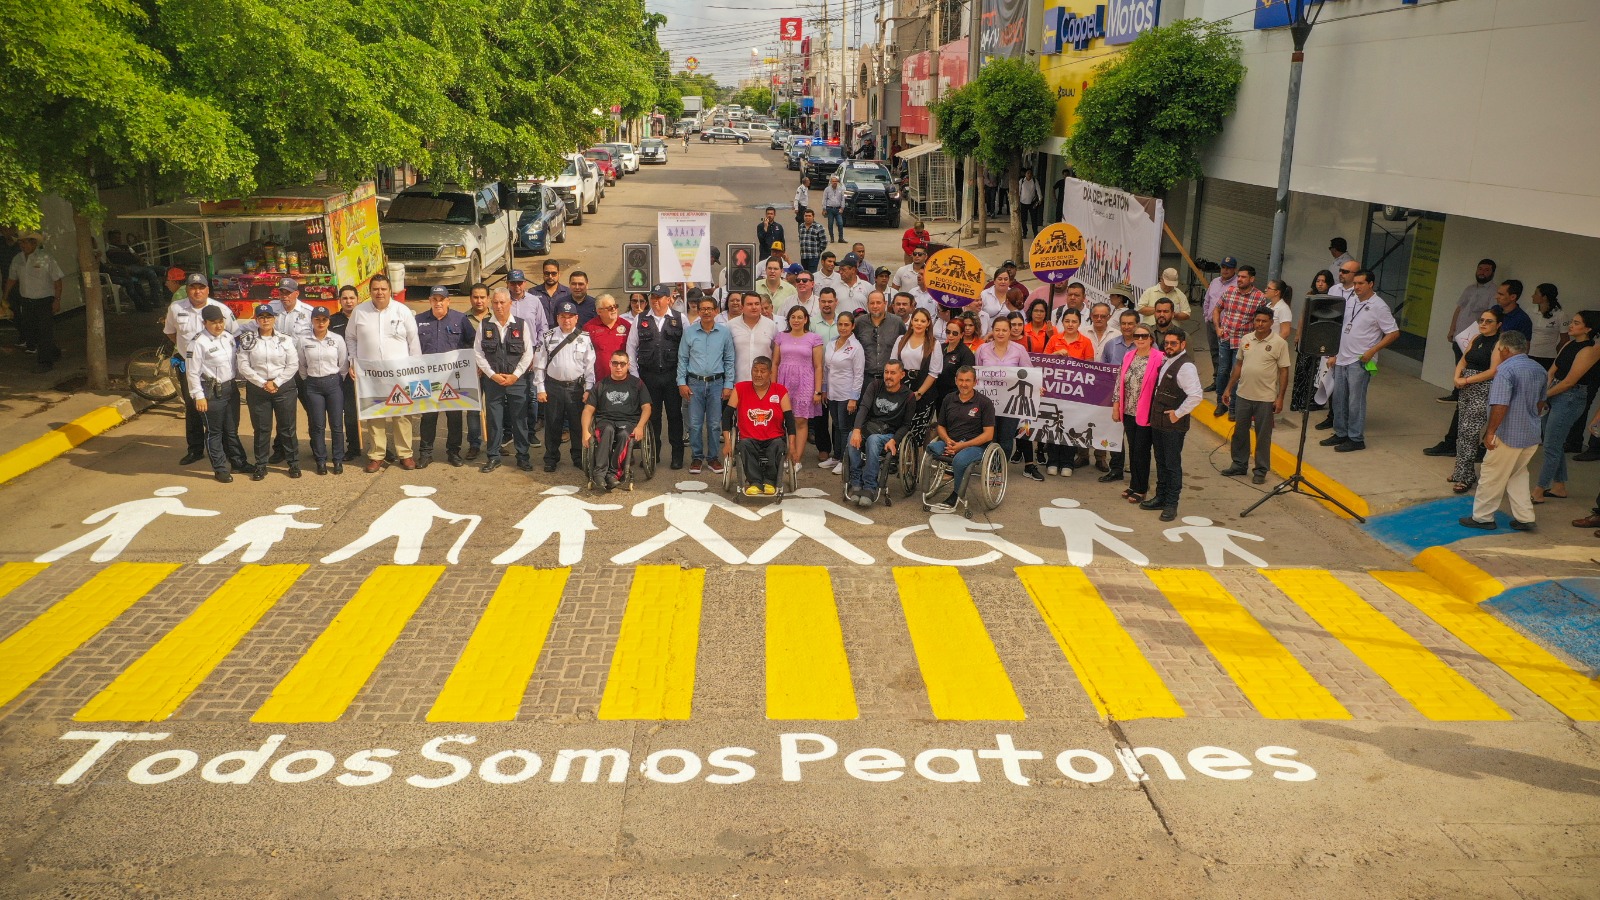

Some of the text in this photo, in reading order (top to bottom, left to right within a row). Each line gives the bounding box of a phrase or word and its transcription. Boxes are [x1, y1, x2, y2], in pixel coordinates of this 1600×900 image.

[1061, 11, 1101, 50] Coppel
[1106, 0, 1154, 38] Motos
[1103, 192, 1130, 212] PEATÓN
[1034, 258, 1079, 269] PEATONES
[929, 279, 975, 296] PEATONES
[935, 276, 972, 289] TODOS SOMOS
[364, 359, 471, 378] ¡TODOS SOMOS PEATONES!
[982, 369, 1007, 379] respeto
[1041, 357, 1066, 365] PASOS
[1066, 360, 1111, 373] PEATONALES
[1043, 366, 1096, 386] PETAR
[1044, 380, 1085, 398] VIDA
[55, 731, 1317, 788] Todos Somos Peatones
